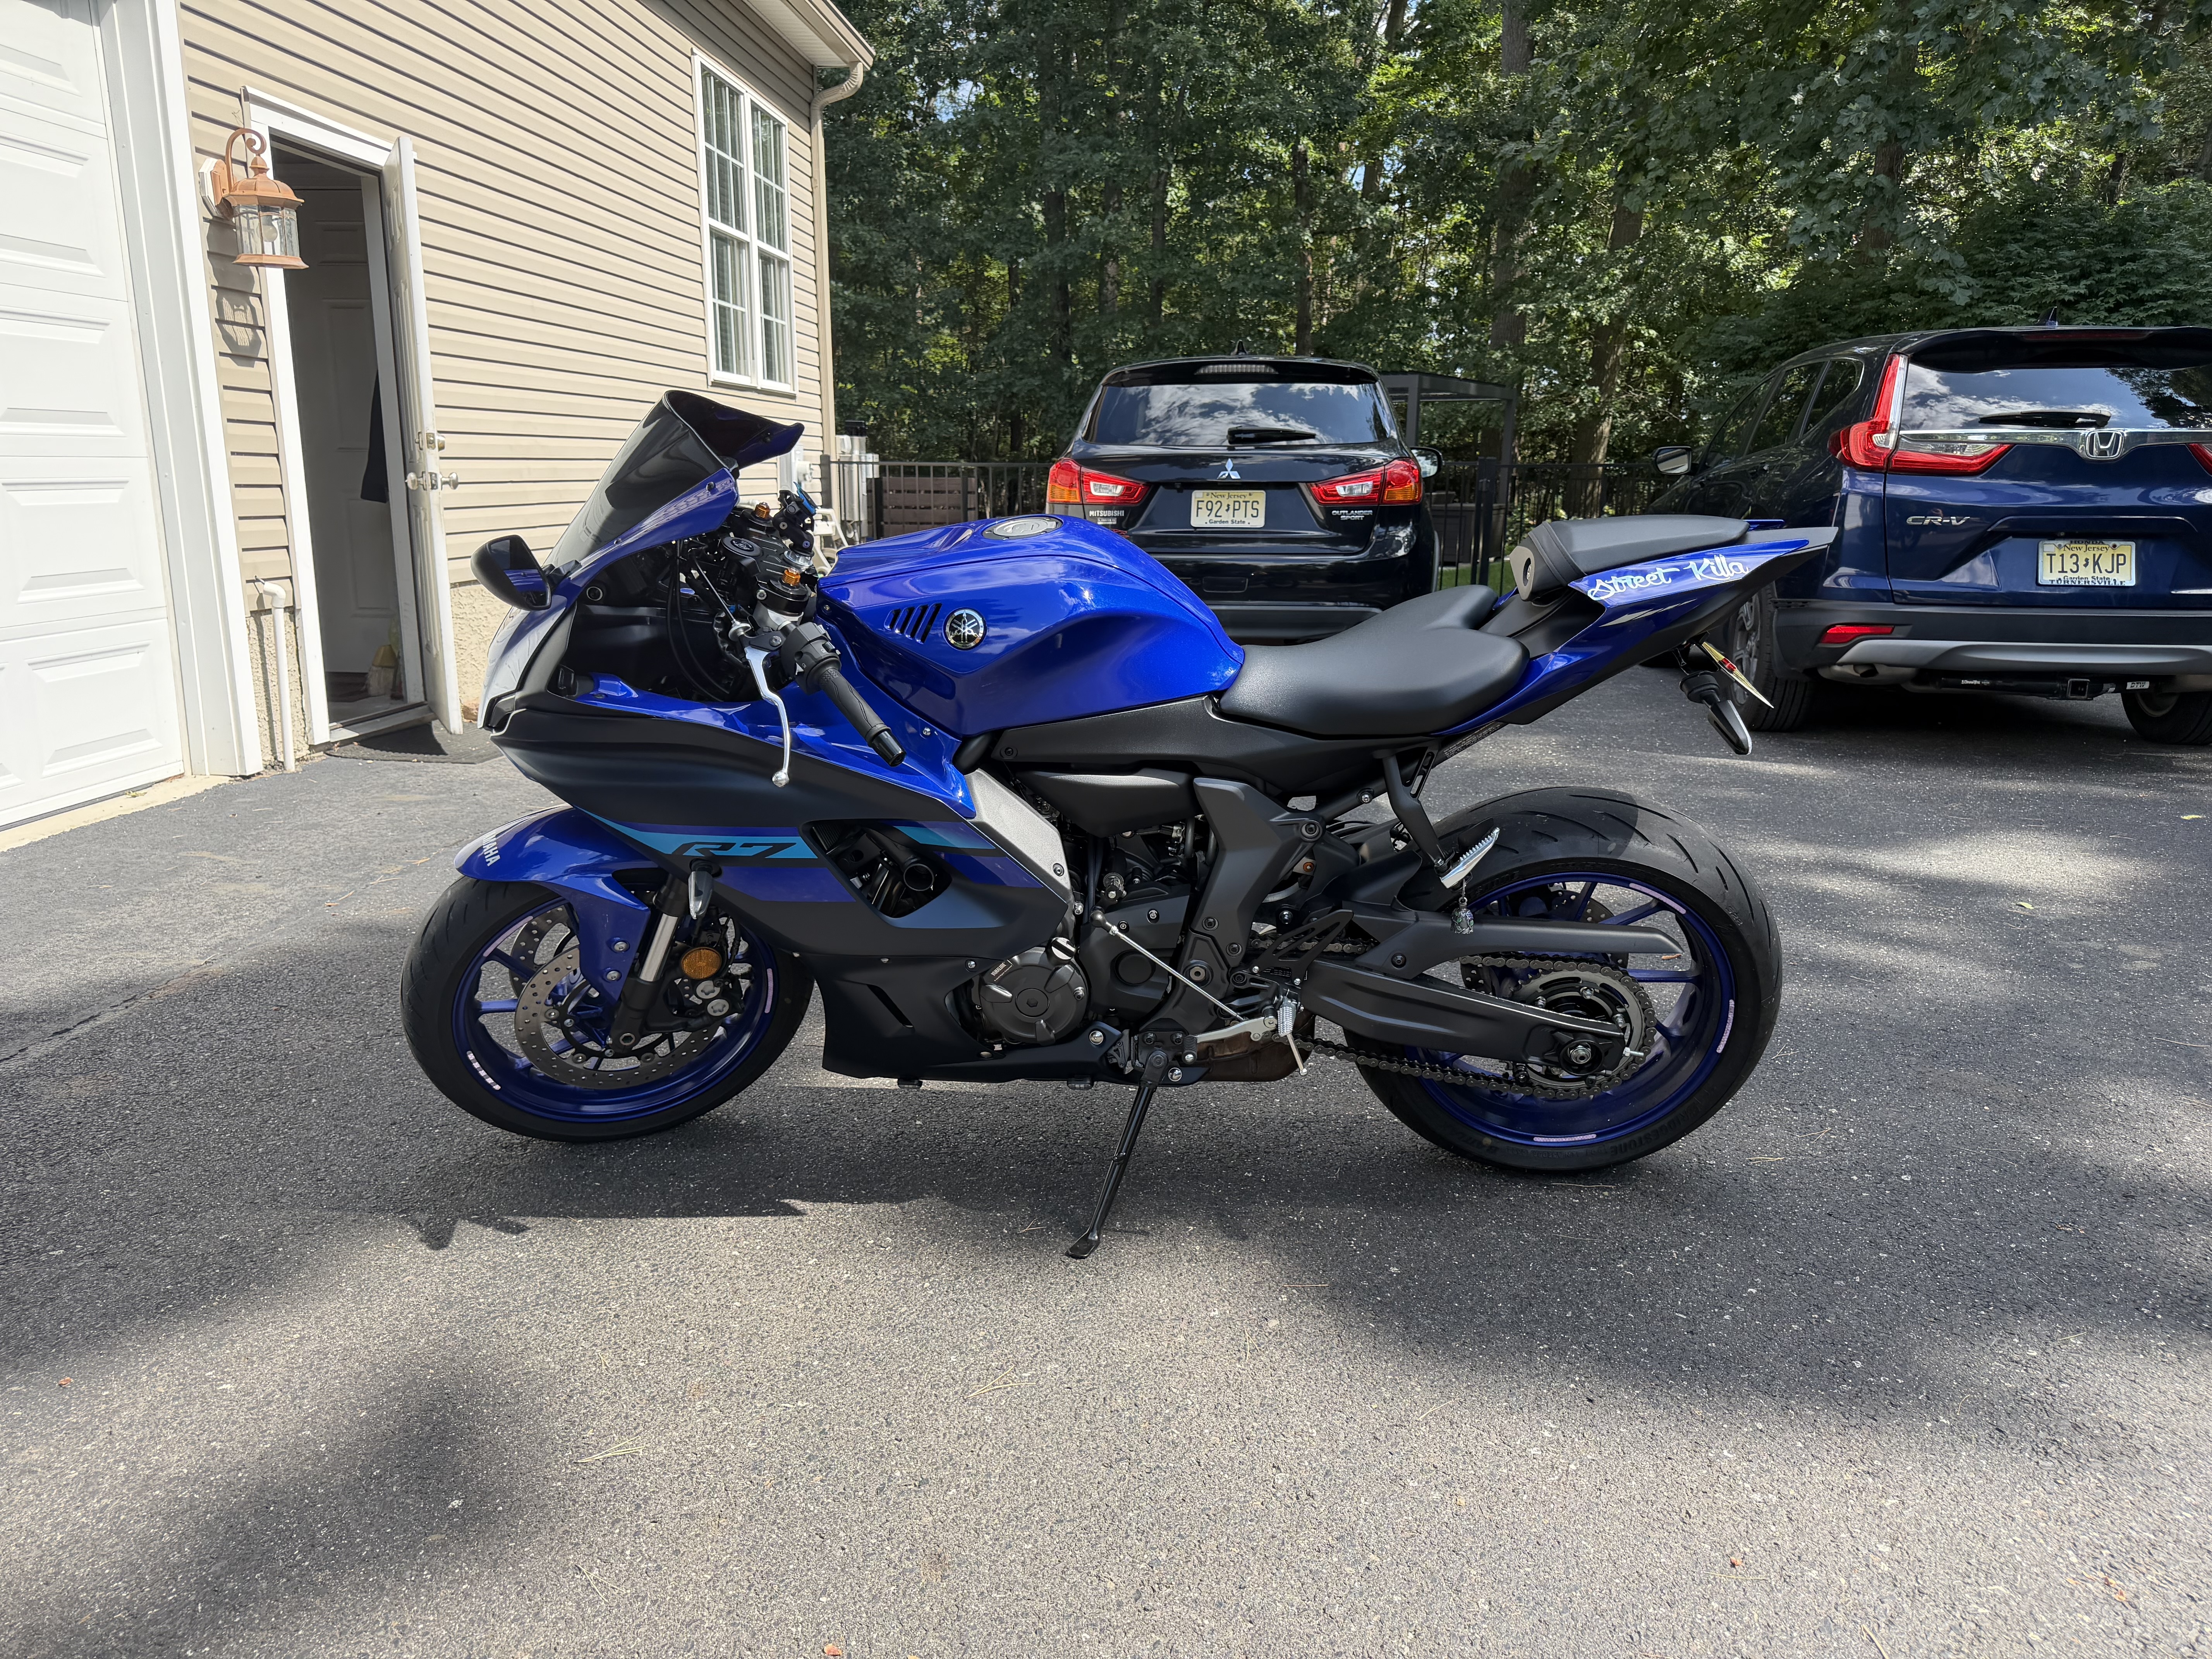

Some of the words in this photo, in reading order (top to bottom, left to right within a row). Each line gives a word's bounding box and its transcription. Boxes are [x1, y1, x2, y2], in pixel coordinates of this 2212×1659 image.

[1196, 500, 1222, 517] F92
[1233, 500, 1259, 518] PTS
[1906, 516, 1970, 526] CR-V
[2084, 544, 2110, 553] Jersey
[2046, 553, 2080, 574] T13
[2093, 553, 2126, 574] KJP
[1587, 567, 1680, 600] Street
[1683, 554, 1750, 580] Killa
[672, 842, 797, 858] R7
